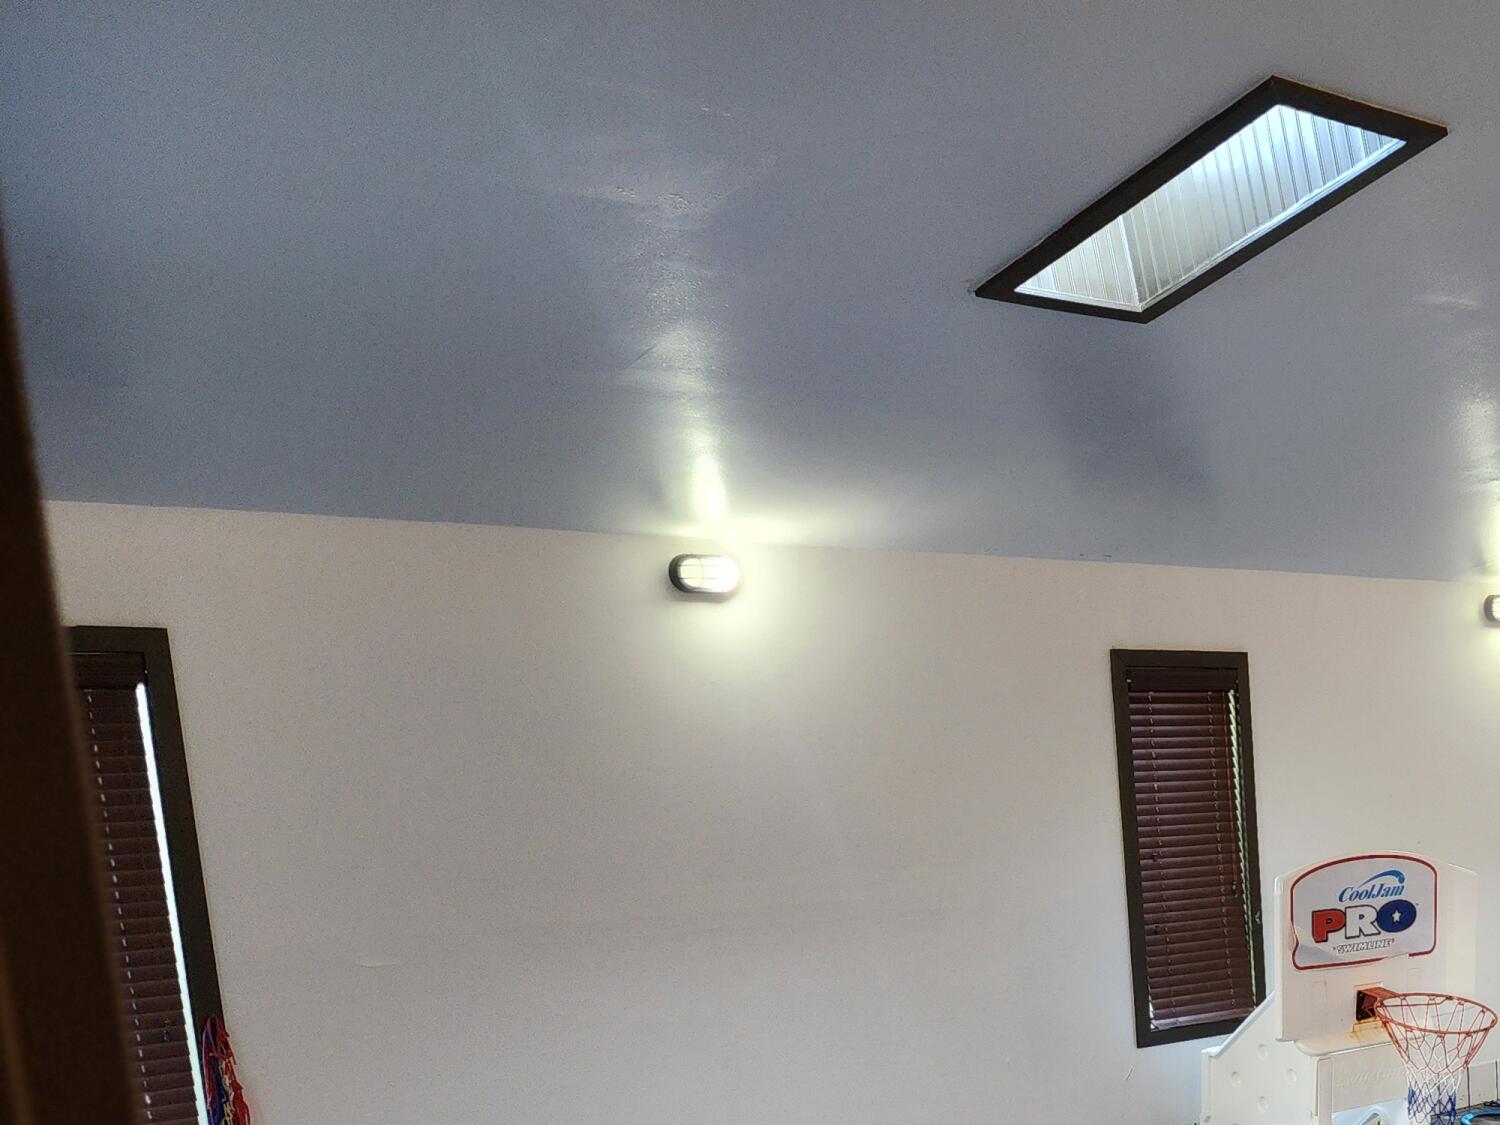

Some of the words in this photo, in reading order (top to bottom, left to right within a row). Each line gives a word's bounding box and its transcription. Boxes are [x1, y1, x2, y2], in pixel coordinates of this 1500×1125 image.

[1338, 883, 1405, 902] CoolJam
[1311, 899, 1417, 943] PRO
[1337, 938, 1392, 954] SWIMLINE
